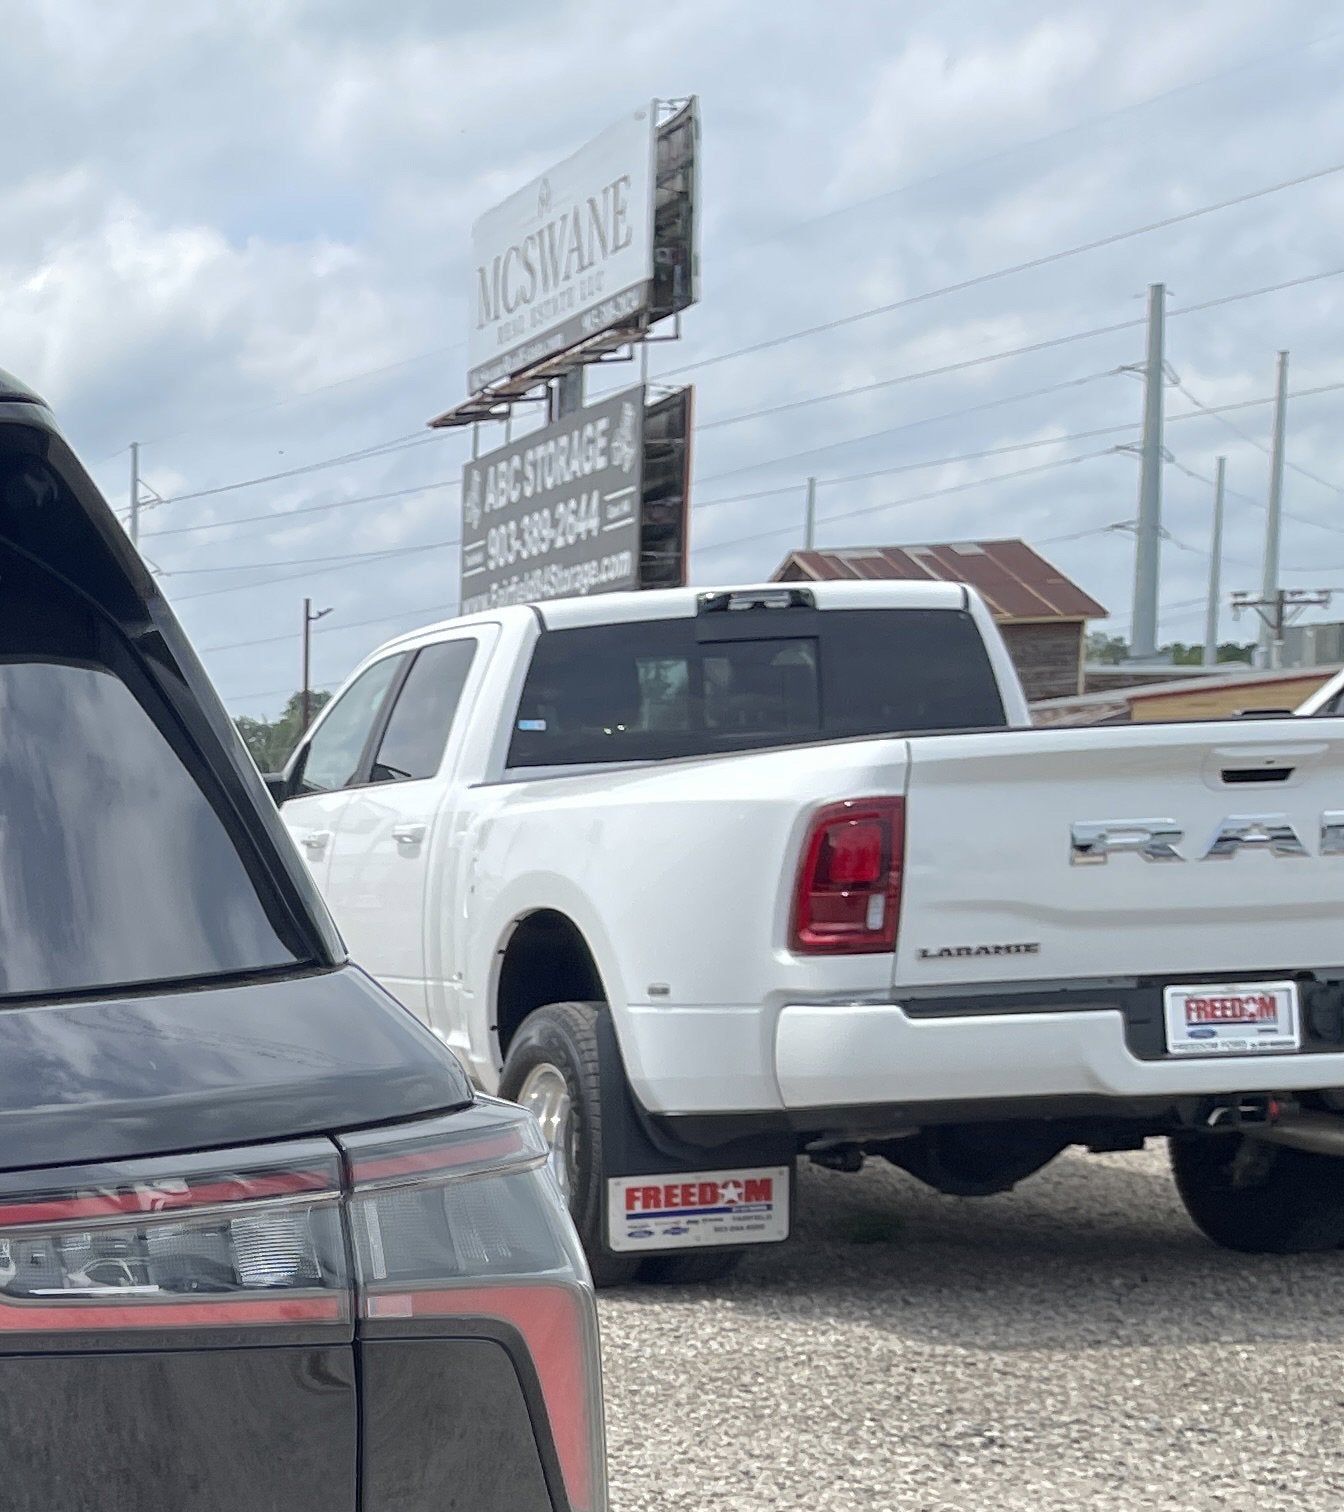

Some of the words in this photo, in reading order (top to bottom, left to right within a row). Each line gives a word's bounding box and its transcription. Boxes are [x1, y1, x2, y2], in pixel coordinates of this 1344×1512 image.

[476, 174, 633, 330] MCSWANE
[484, 454, 522, 514] ABC
[522, 415, 610, 498] STORAGE
[915, 942, 1041, 960] LARAMIE
[1184, 995, 1278, 1023] FREEDOM
[625, 1177, 773, 1211] FREEDOM
